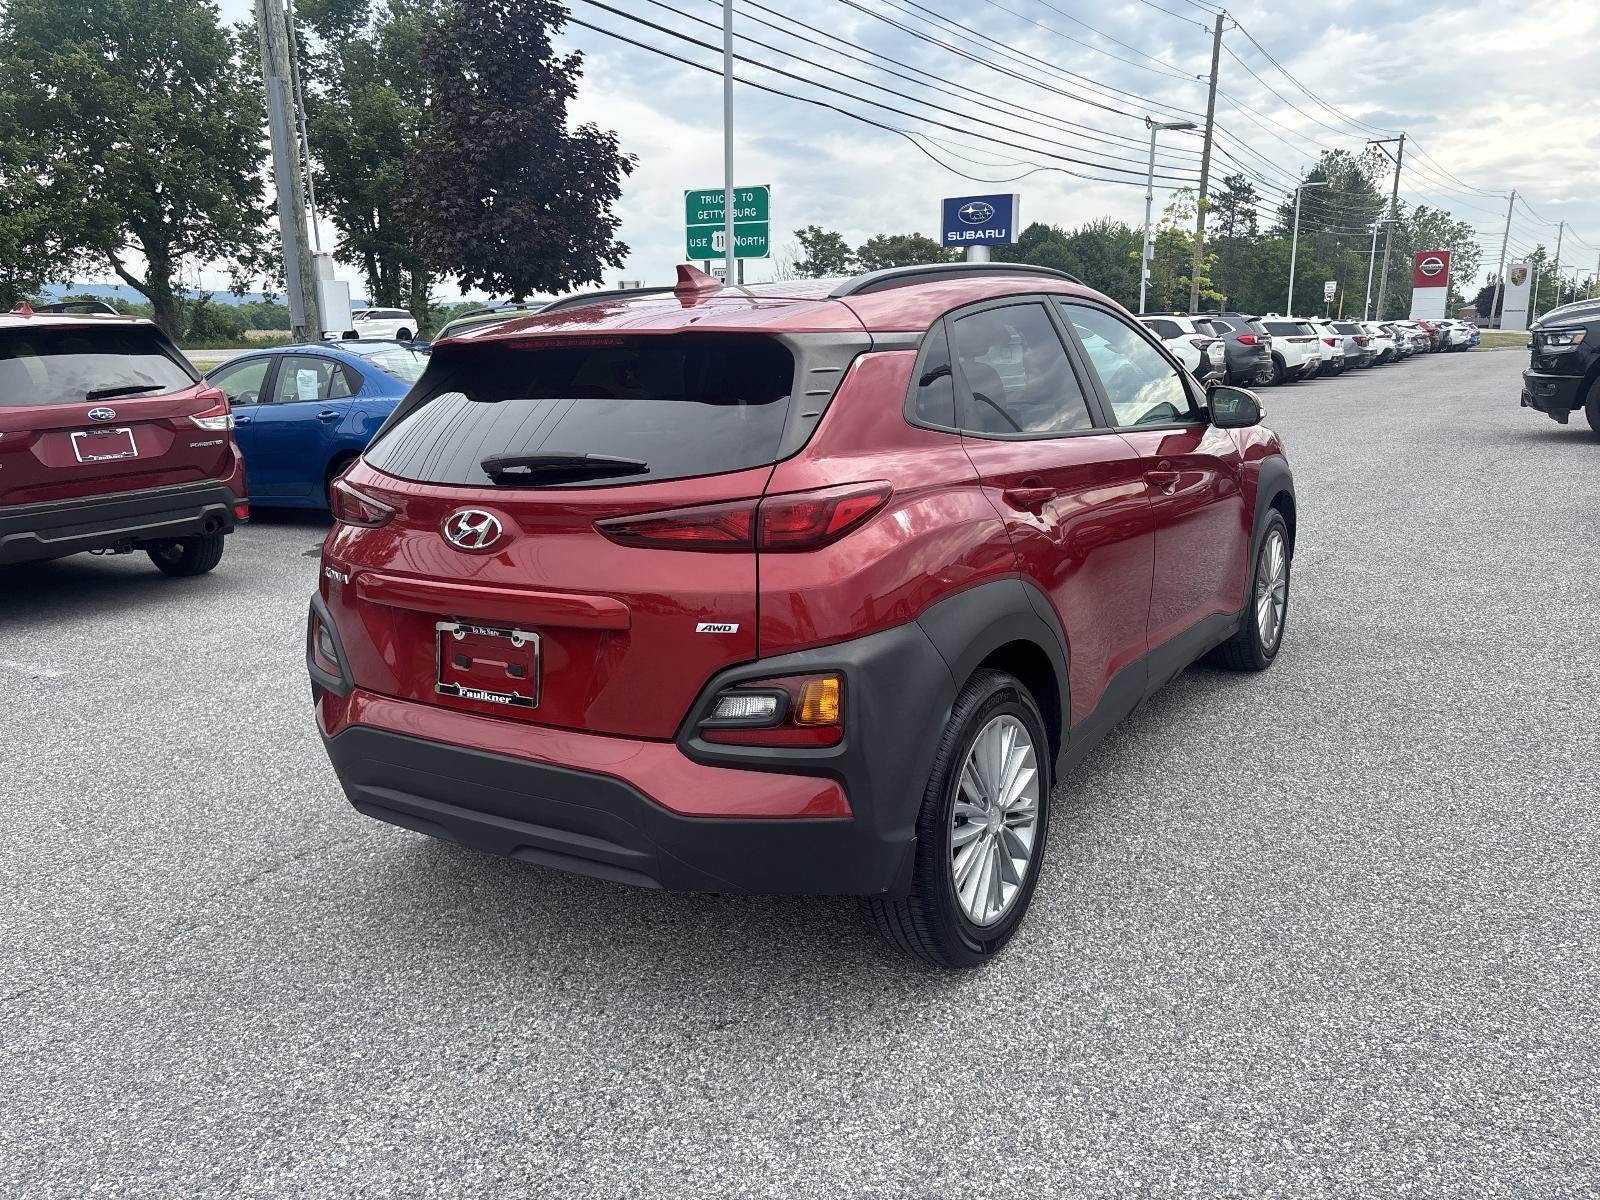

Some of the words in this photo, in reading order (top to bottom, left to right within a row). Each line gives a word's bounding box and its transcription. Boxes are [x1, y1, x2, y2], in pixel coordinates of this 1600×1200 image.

[701, 194, 736, 204] TRUCS
[742, 193, 753, 202] TO
[698, 208, 756, 219] GETTYBURG
[948, 229, 1006, 241] SUBARU
[690, 238, 708, 247] USE
[716, 235, 724, 248] 11
[734, 236, 765, 246] NORTH
[700, 624, 732, 632] AWD
[459, 688, 512, 704] Faulkner
